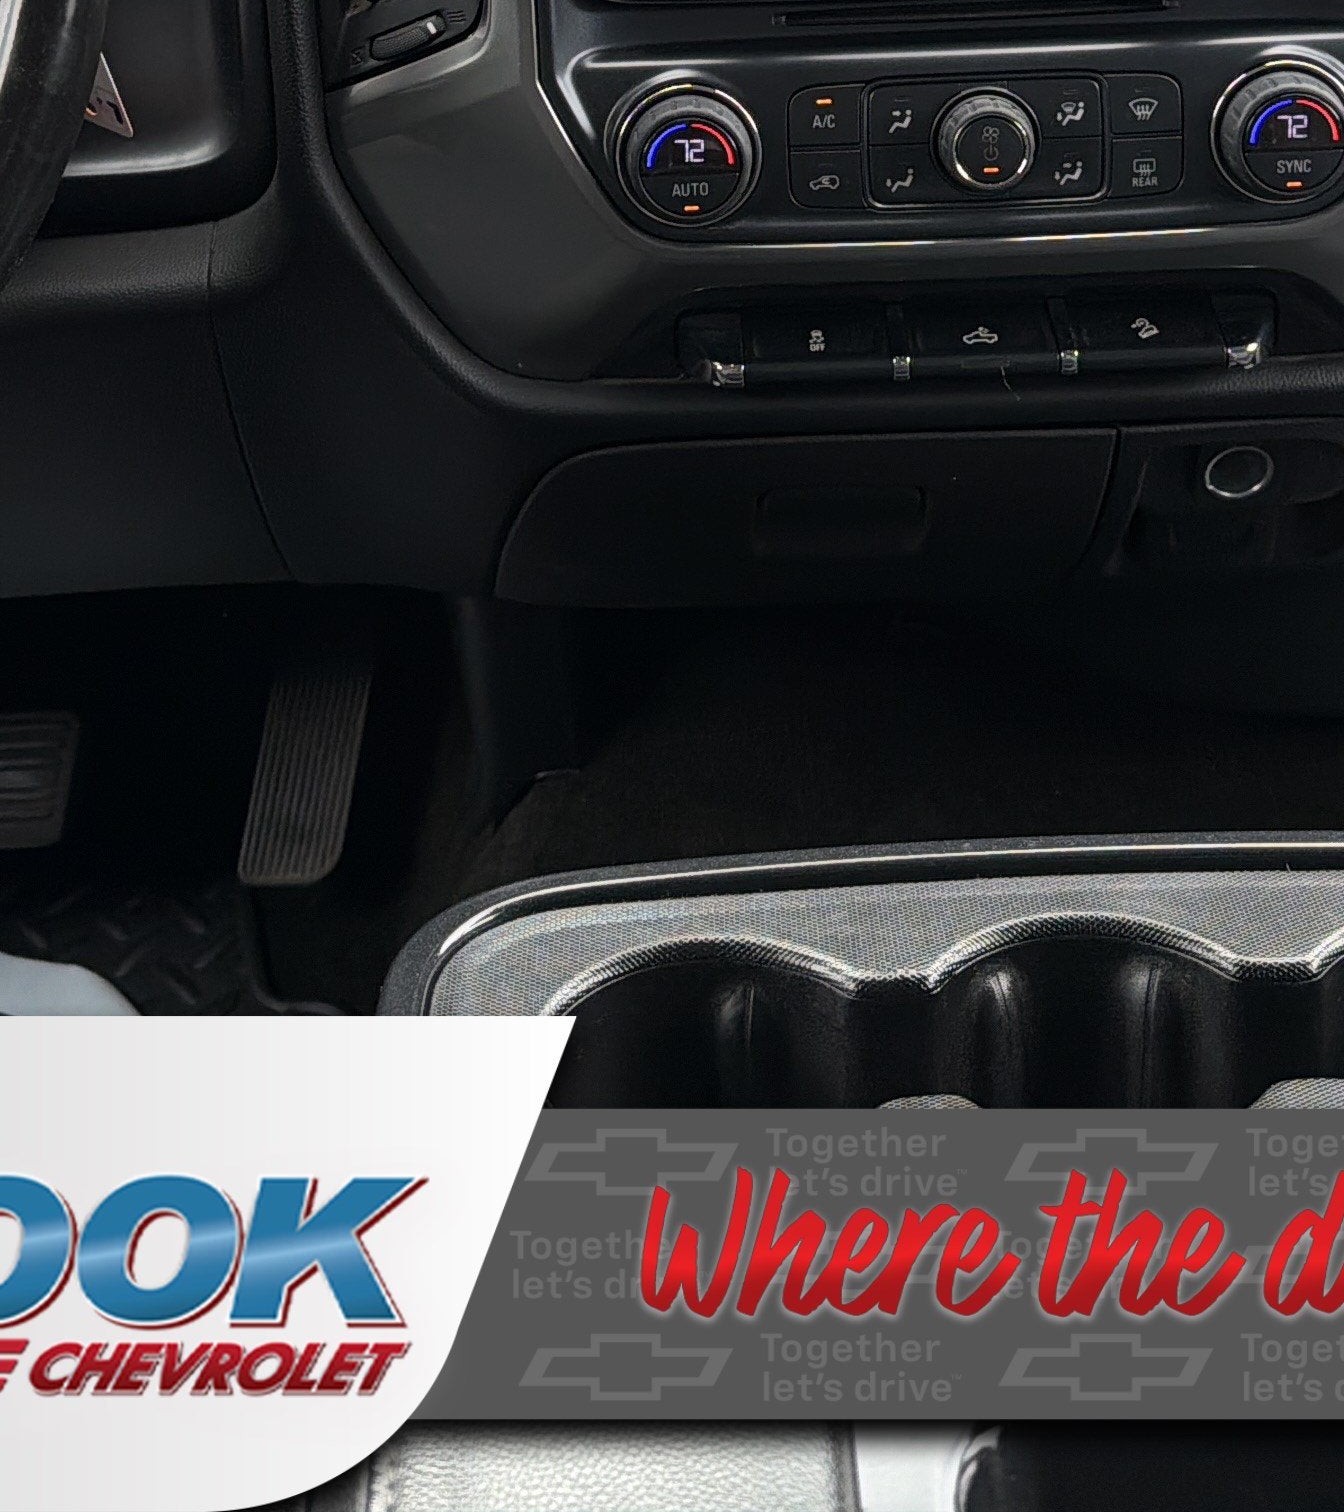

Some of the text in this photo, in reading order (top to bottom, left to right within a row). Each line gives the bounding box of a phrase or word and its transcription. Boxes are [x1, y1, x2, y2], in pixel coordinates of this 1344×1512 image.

[812, 113, 836, 129] A/C
[1277, 114, 1308, 139] 72
[674, 138, 705, 163] 72
[1276, 159, 1312, 175] SYNC
[671, 181, 709, 198] AUTO
[1131, 176, 1158, 187] REAR
